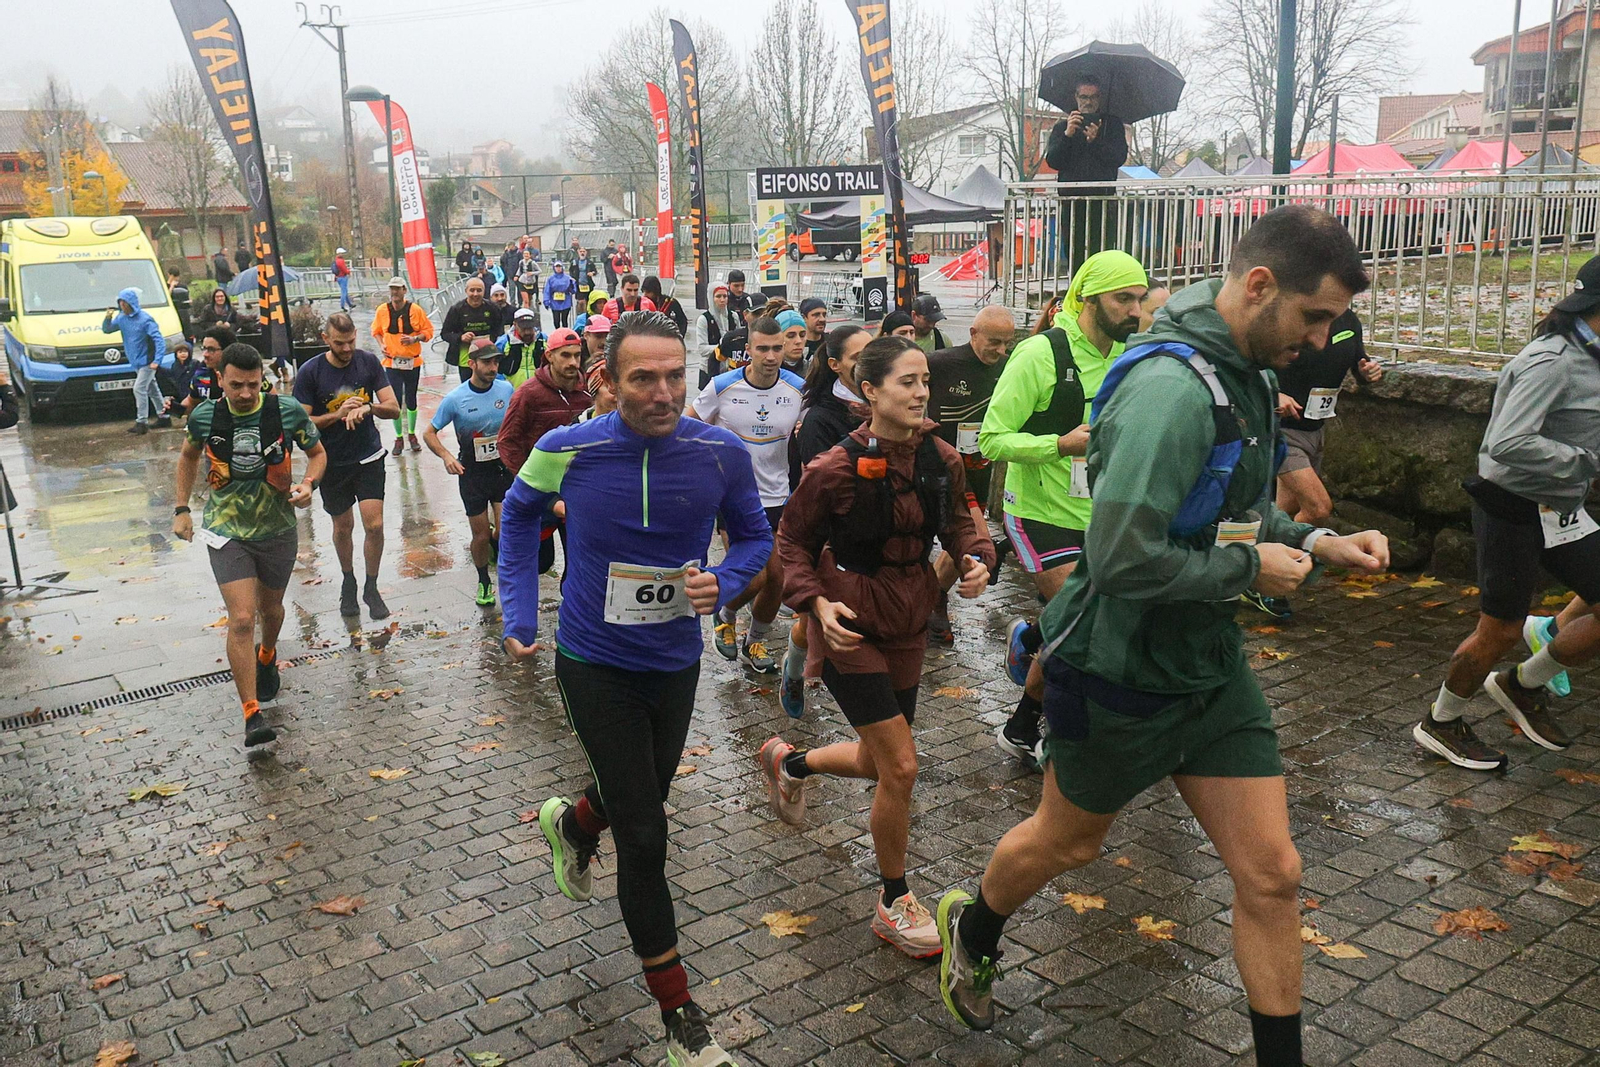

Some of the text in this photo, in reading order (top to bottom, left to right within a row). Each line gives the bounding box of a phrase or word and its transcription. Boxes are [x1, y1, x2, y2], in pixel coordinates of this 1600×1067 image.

[762, 171, 879, 194] EIFONSO TRAIL
[1320, 397, 1333, 409] 29
[636, 584, 676, 604] 60
